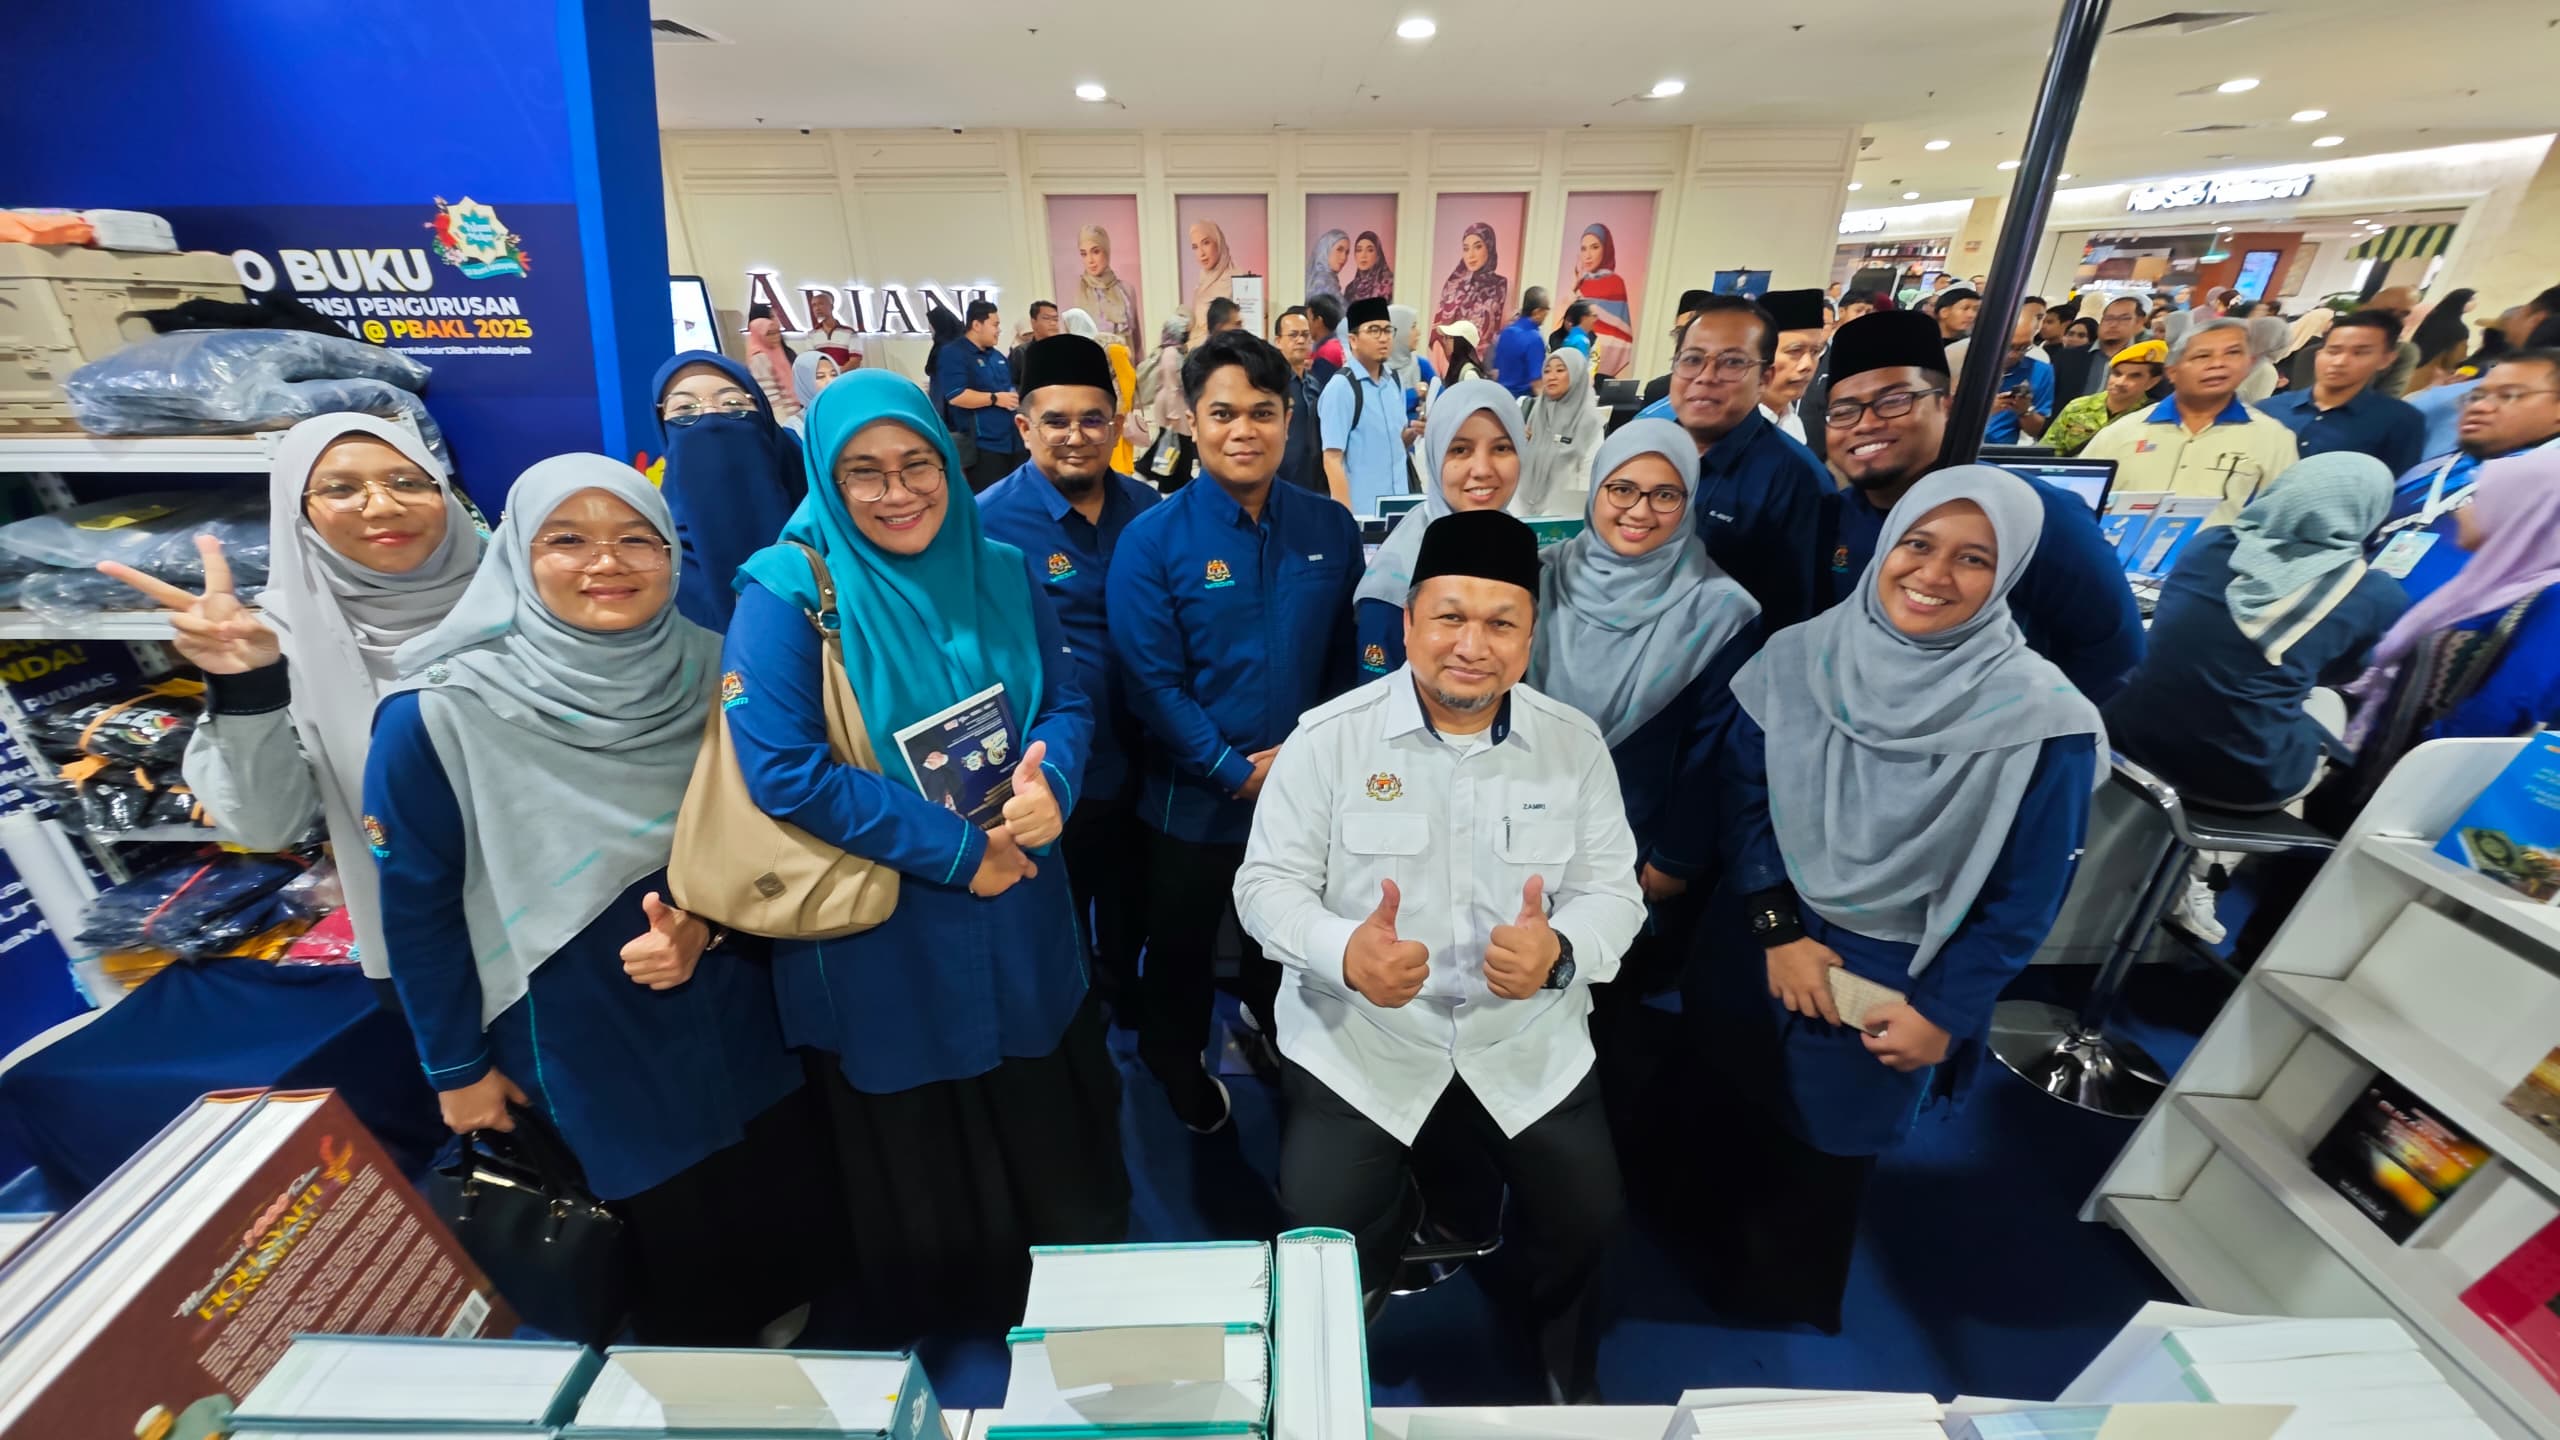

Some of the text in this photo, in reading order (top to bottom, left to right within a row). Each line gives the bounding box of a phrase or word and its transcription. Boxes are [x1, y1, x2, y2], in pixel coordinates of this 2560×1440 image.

[231, 249, 433, 292] O BUKU
[356, 297, 520, 317] PENGURUSAN
[362, 320, 388, 343] @
[393, 319, 473, 339] PBAKL
[473, 319, 533, 339] 2025
[0, 644, 88, 683] NDA!
